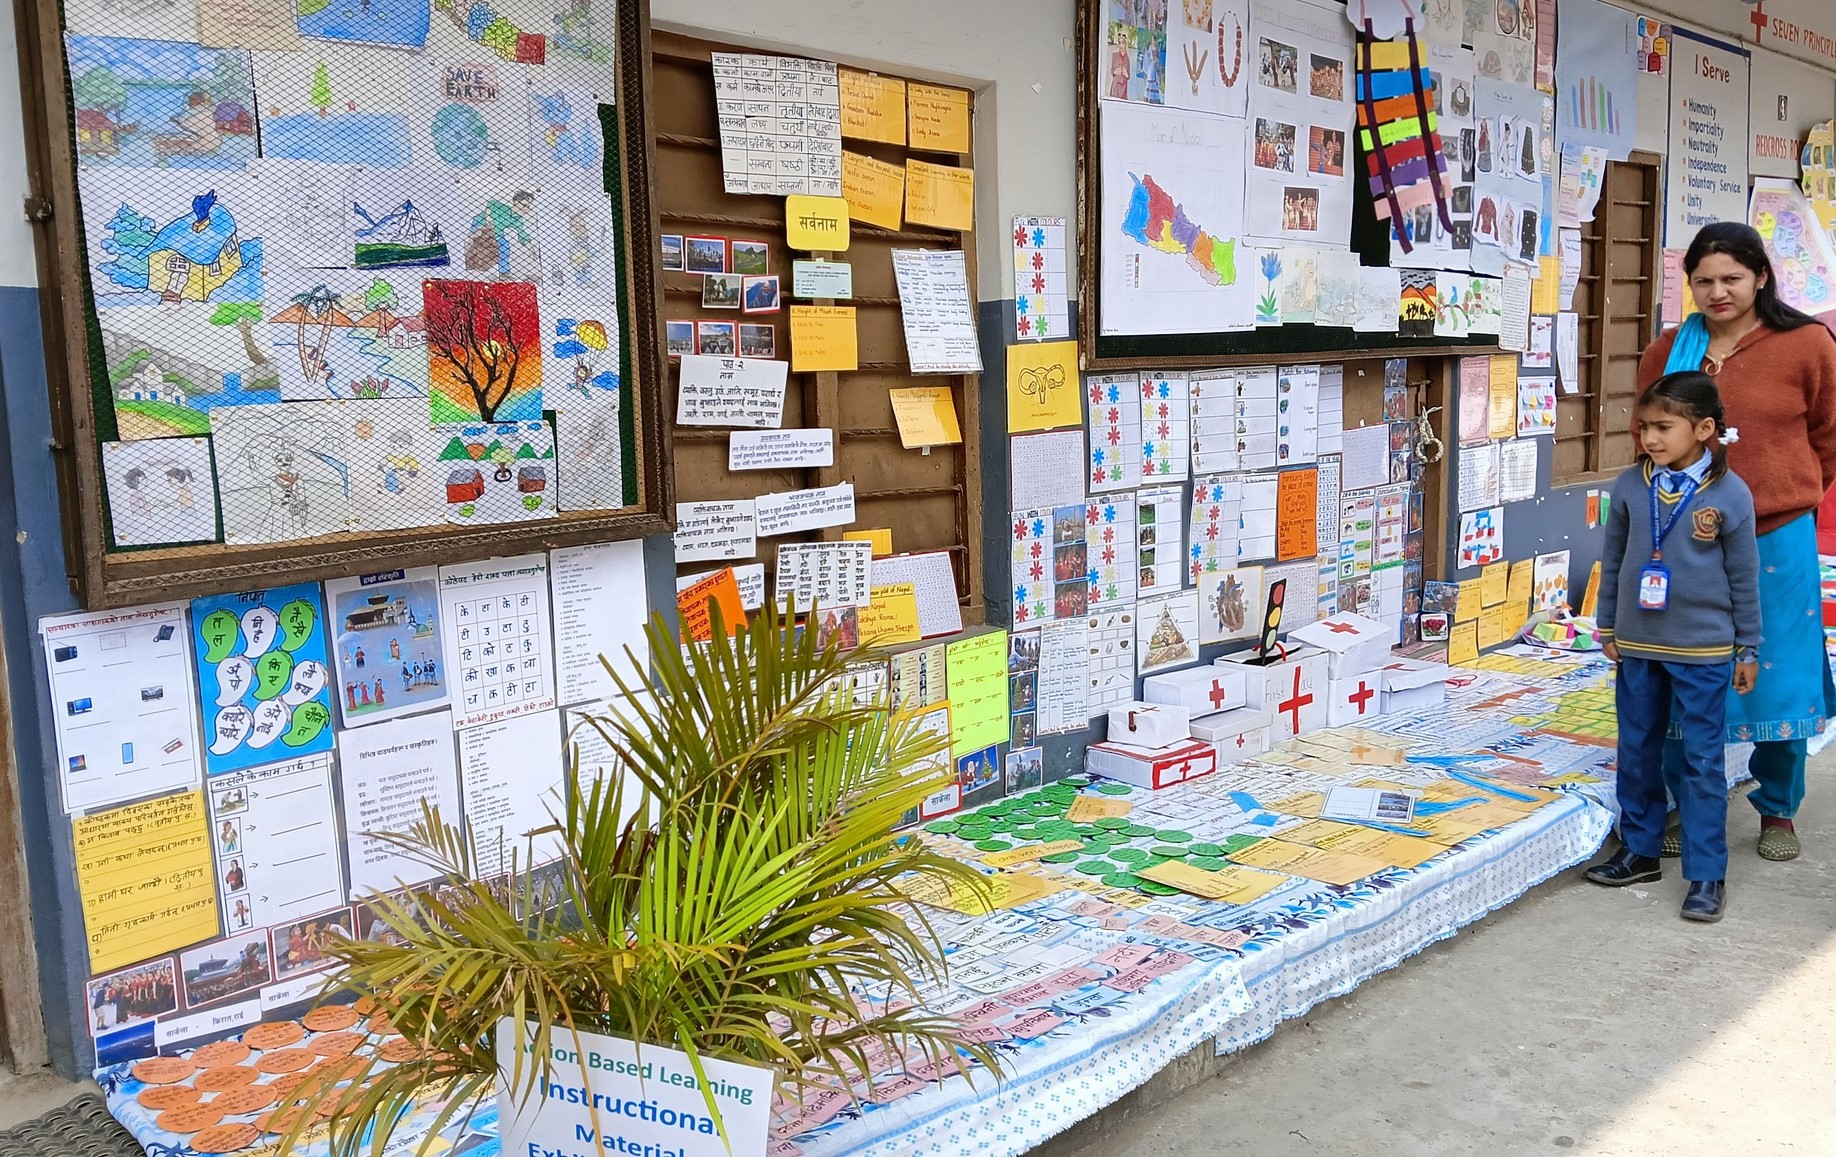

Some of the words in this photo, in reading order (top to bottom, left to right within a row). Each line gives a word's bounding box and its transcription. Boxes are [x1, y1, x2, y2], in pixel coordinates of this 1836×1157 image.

[1773, 18, 1799, 43] SEVEN
[1804, 29, 1836, 58] PRINCIPL
[714, 56, 740, 65] कारक
[1695, 54, 1698, 74] I
[1703, 57, 1730, 83] Serve
[446, 67, 483, 83] SAVE
[446, 82, 498, 99] EARTH
[1689, 100, 1717, 120] Humanity
[1688, 119, 1724, 140] Impartiality
[1688, 138, 1719, 157] Neutrality
[1756, 134, 1786, 159] REDCROSS
[1688, 158, 1727, 173] Independence
[1688, 177, 1716, 193] Voluntary
[1720, 182, 1741, 194] Service
[1687, 194, 1702, 210] Unity
[799, 216, 838, 231] सर्वनाम
[1687, 212, 1720, 226] Universality
[460, 605, 469, 617] के
[481, 603, 490, 612] टा
[502, 597, 511, 609] के
[520, 595, 529, 606] टी
[461, 628, 470, 640] टी
[483, 627, 490, 636] उ
[502, 623, 512, 633] टा
[482, 642, 495, 656] को
[465, 668, 478, 682] की
[486, 666, 498, 678] खा
[505, 664, 516, 674] क
[523, 658, 537, 669] चा
[488, 689, 498, 700] क
[506, 682, 518, 697] टी
[525, 681, 537, 693] टा
[1265, 679, 1285, 703] First
[259, 768, 280, 778] काम
[931, 793, 950, 805] साकेला
[1018, 849, 1044, 858] very
[1044, 842, 1081, 851] happy
[98, 887, 119, 904] हामी
[120, 886, 134, 895] घर
[1106, 944, 1141, 964] नदी
[268, 991, 290, 1003] साकेला
[166, 1026, 188, 1038] साकेला
[589, 1052, 653, 1079] Based
